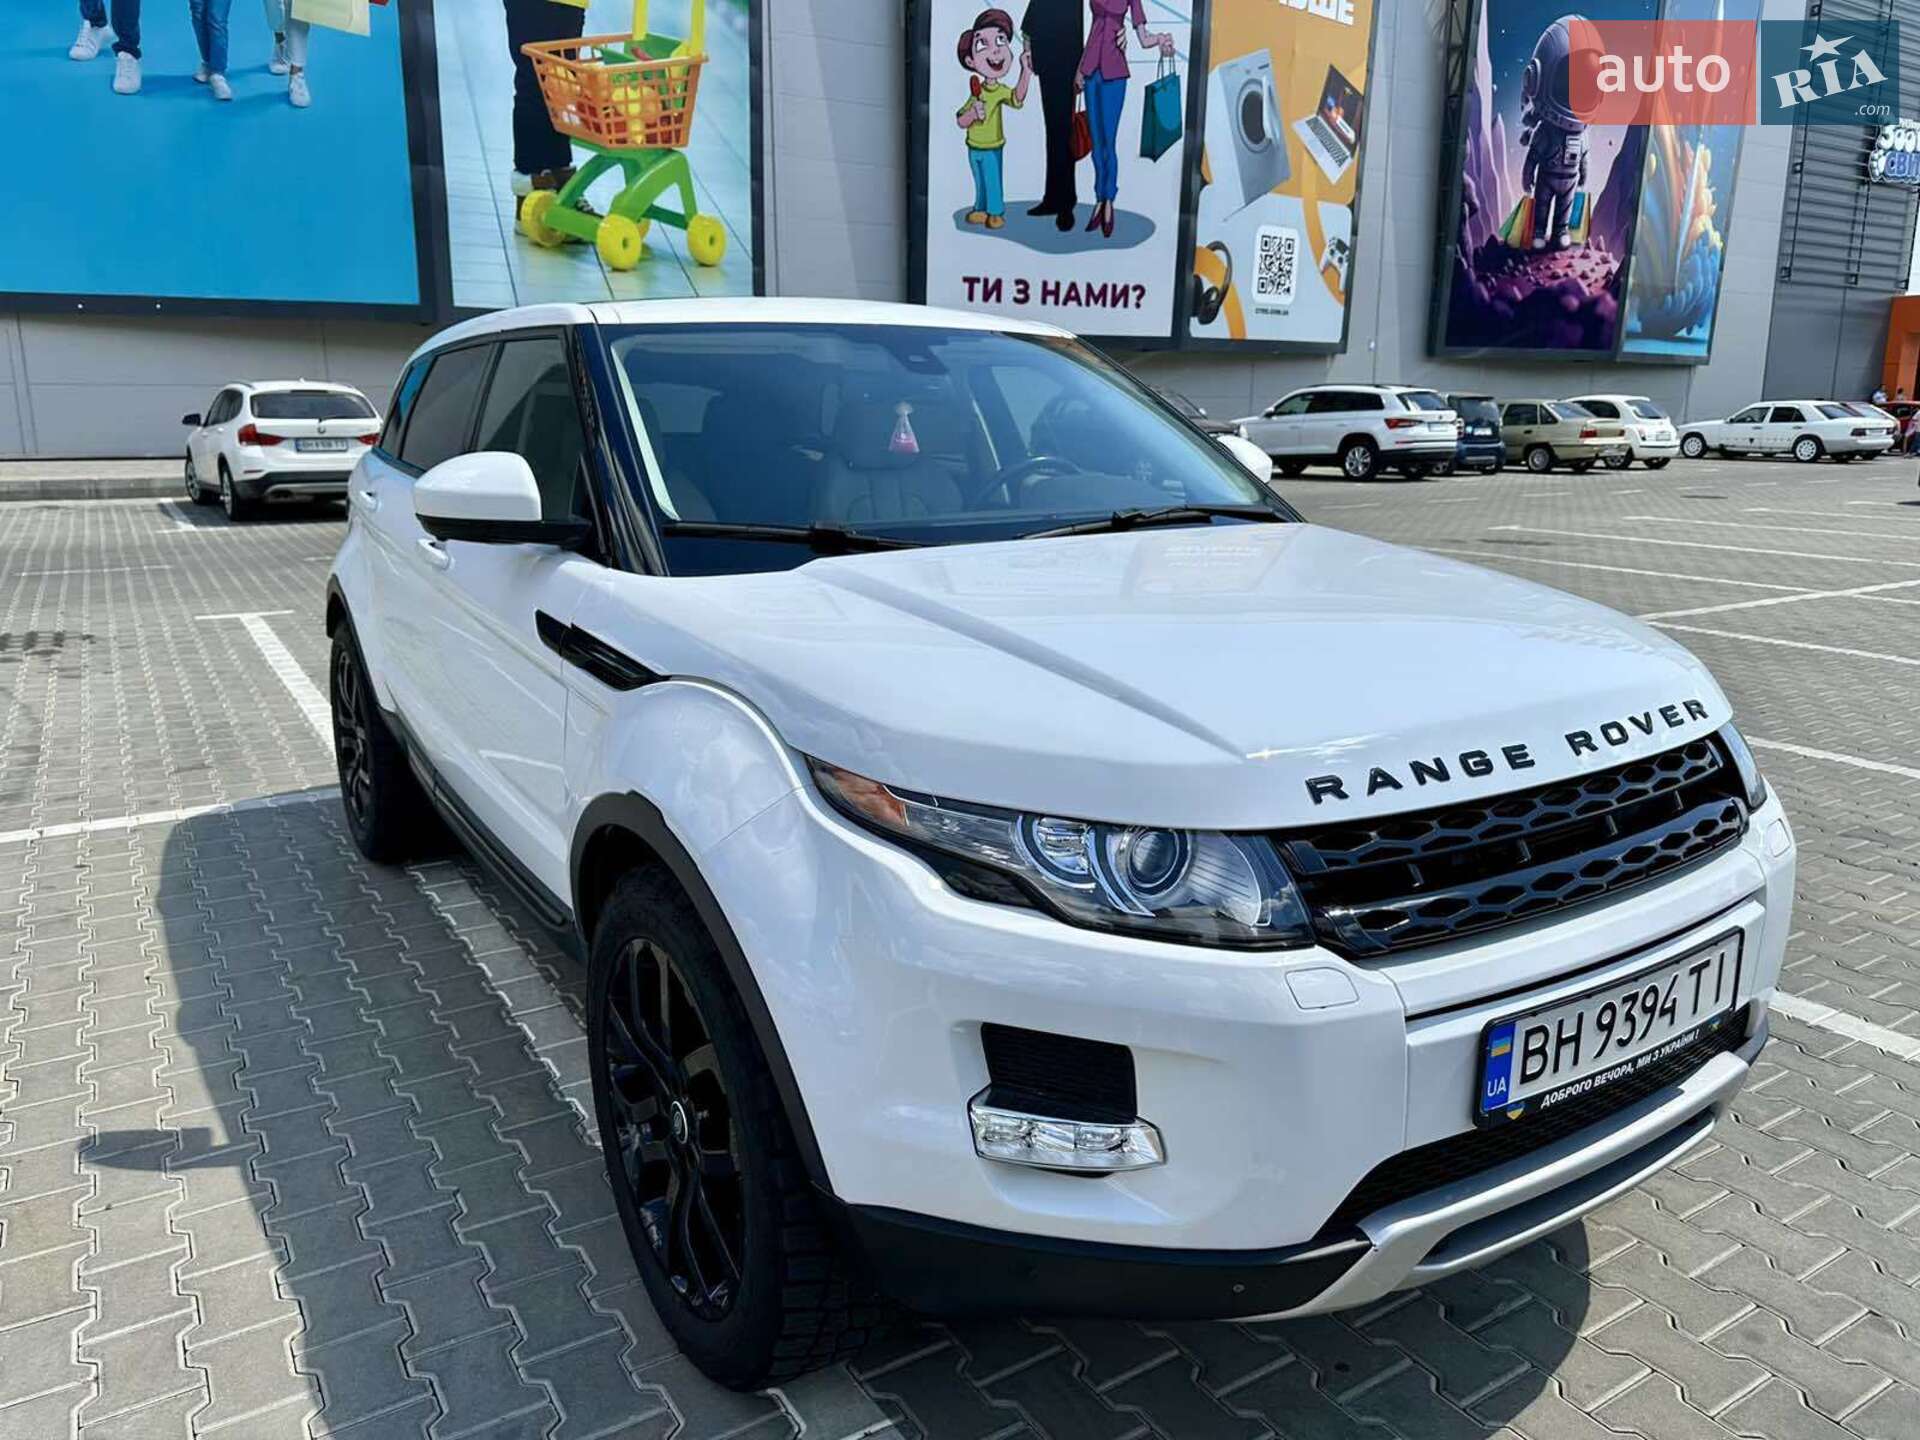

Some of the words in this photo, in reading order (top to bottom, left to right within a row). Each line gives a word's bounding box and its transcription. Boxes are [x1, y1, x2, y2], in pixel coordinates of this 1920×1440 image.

[962, 276, 1003, 304] ТИ
[1012, 278, 1031, 305] З
[1040, 280, 1147, 309] НАМИ?
[1305, 743, 1536, 806] RANGE
[1564, 699, 1709, 757] ROVER
[1593, 974, 1680, 1059] 9394
[1487, 1076, 1508, 1098] UA
[1540, 1078, 1593, 1110] ДОБРОГО
